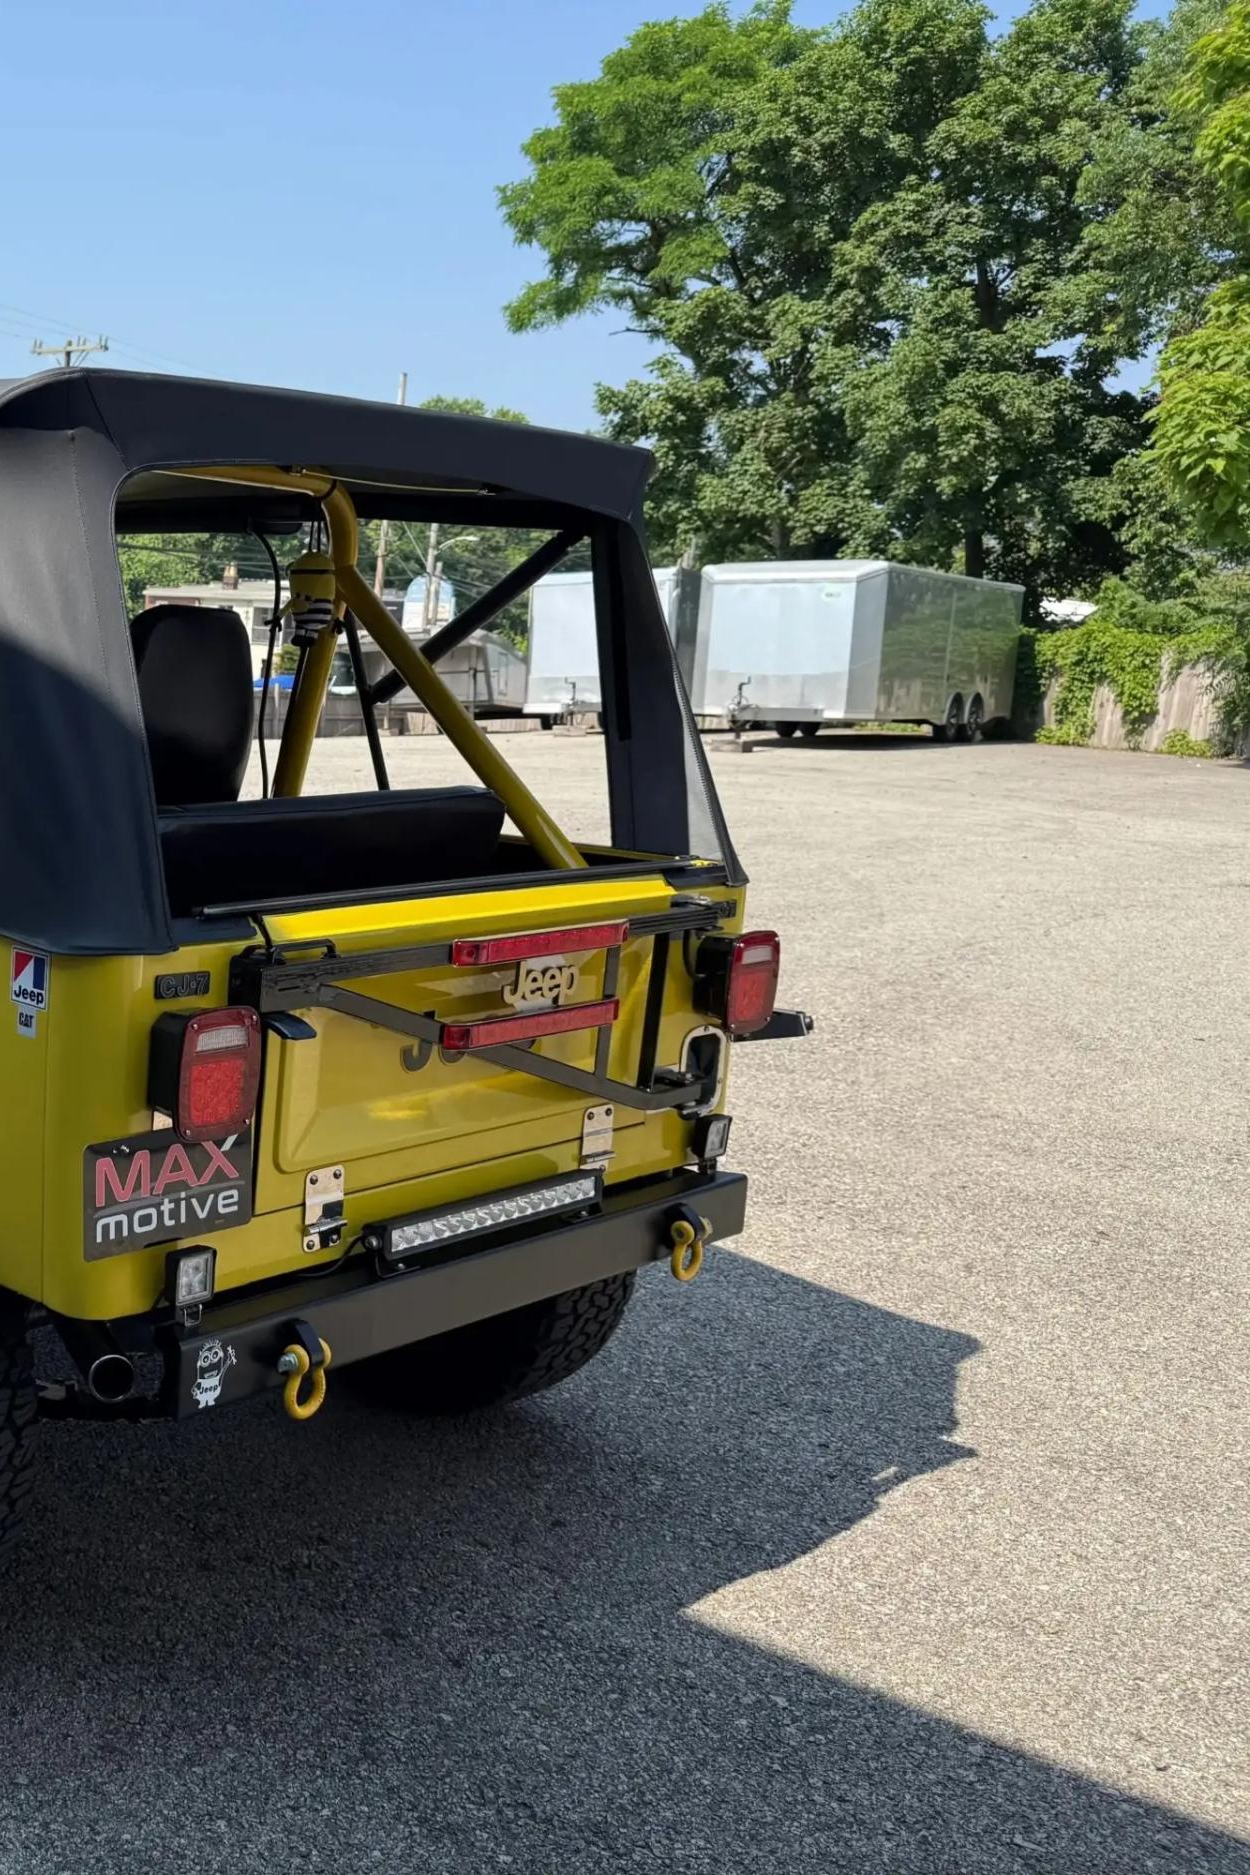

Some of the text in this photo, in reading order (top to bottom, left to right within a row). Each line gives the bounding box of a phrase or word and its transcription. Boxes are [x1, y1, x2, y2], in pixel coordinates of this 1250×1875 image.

[14, 985, 44, 1005] Jeep
[160, 973, 208, 998] CJ-7
[502, 960, 580, 1006] Jeep
[18, 1012, 35, 1028] CAT
[95, 1134, 239, 1208] MAX
[96, 1188, 239, 1244] motive
[199, 1383, 219, 1395] Jeep
